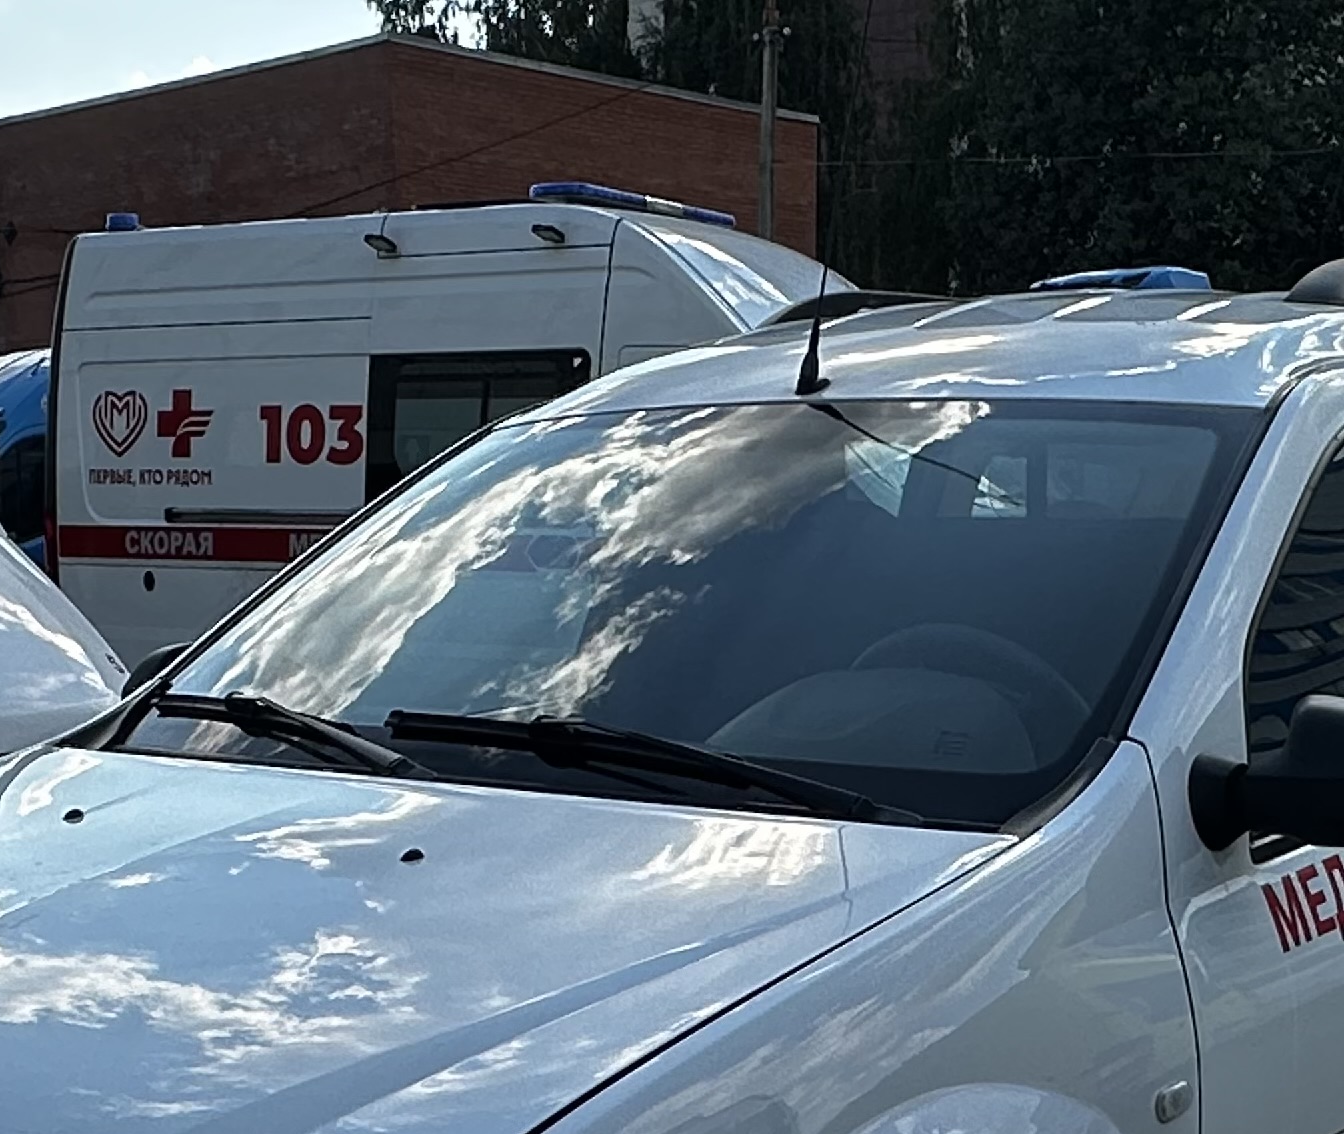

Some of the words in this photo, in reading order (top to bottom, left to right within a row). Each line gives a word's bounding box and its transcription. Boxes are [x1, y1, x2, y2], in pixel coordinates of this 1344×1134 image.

[260, 404, 364, 465] 103
[88, 468, 136, 487] ПЕРВЫЕ,
[138, 468, 164, 486] КТО
[166, 468, 214, 487] РЯДОМ
[125, 531, 215, 556] СКОРАЯ
